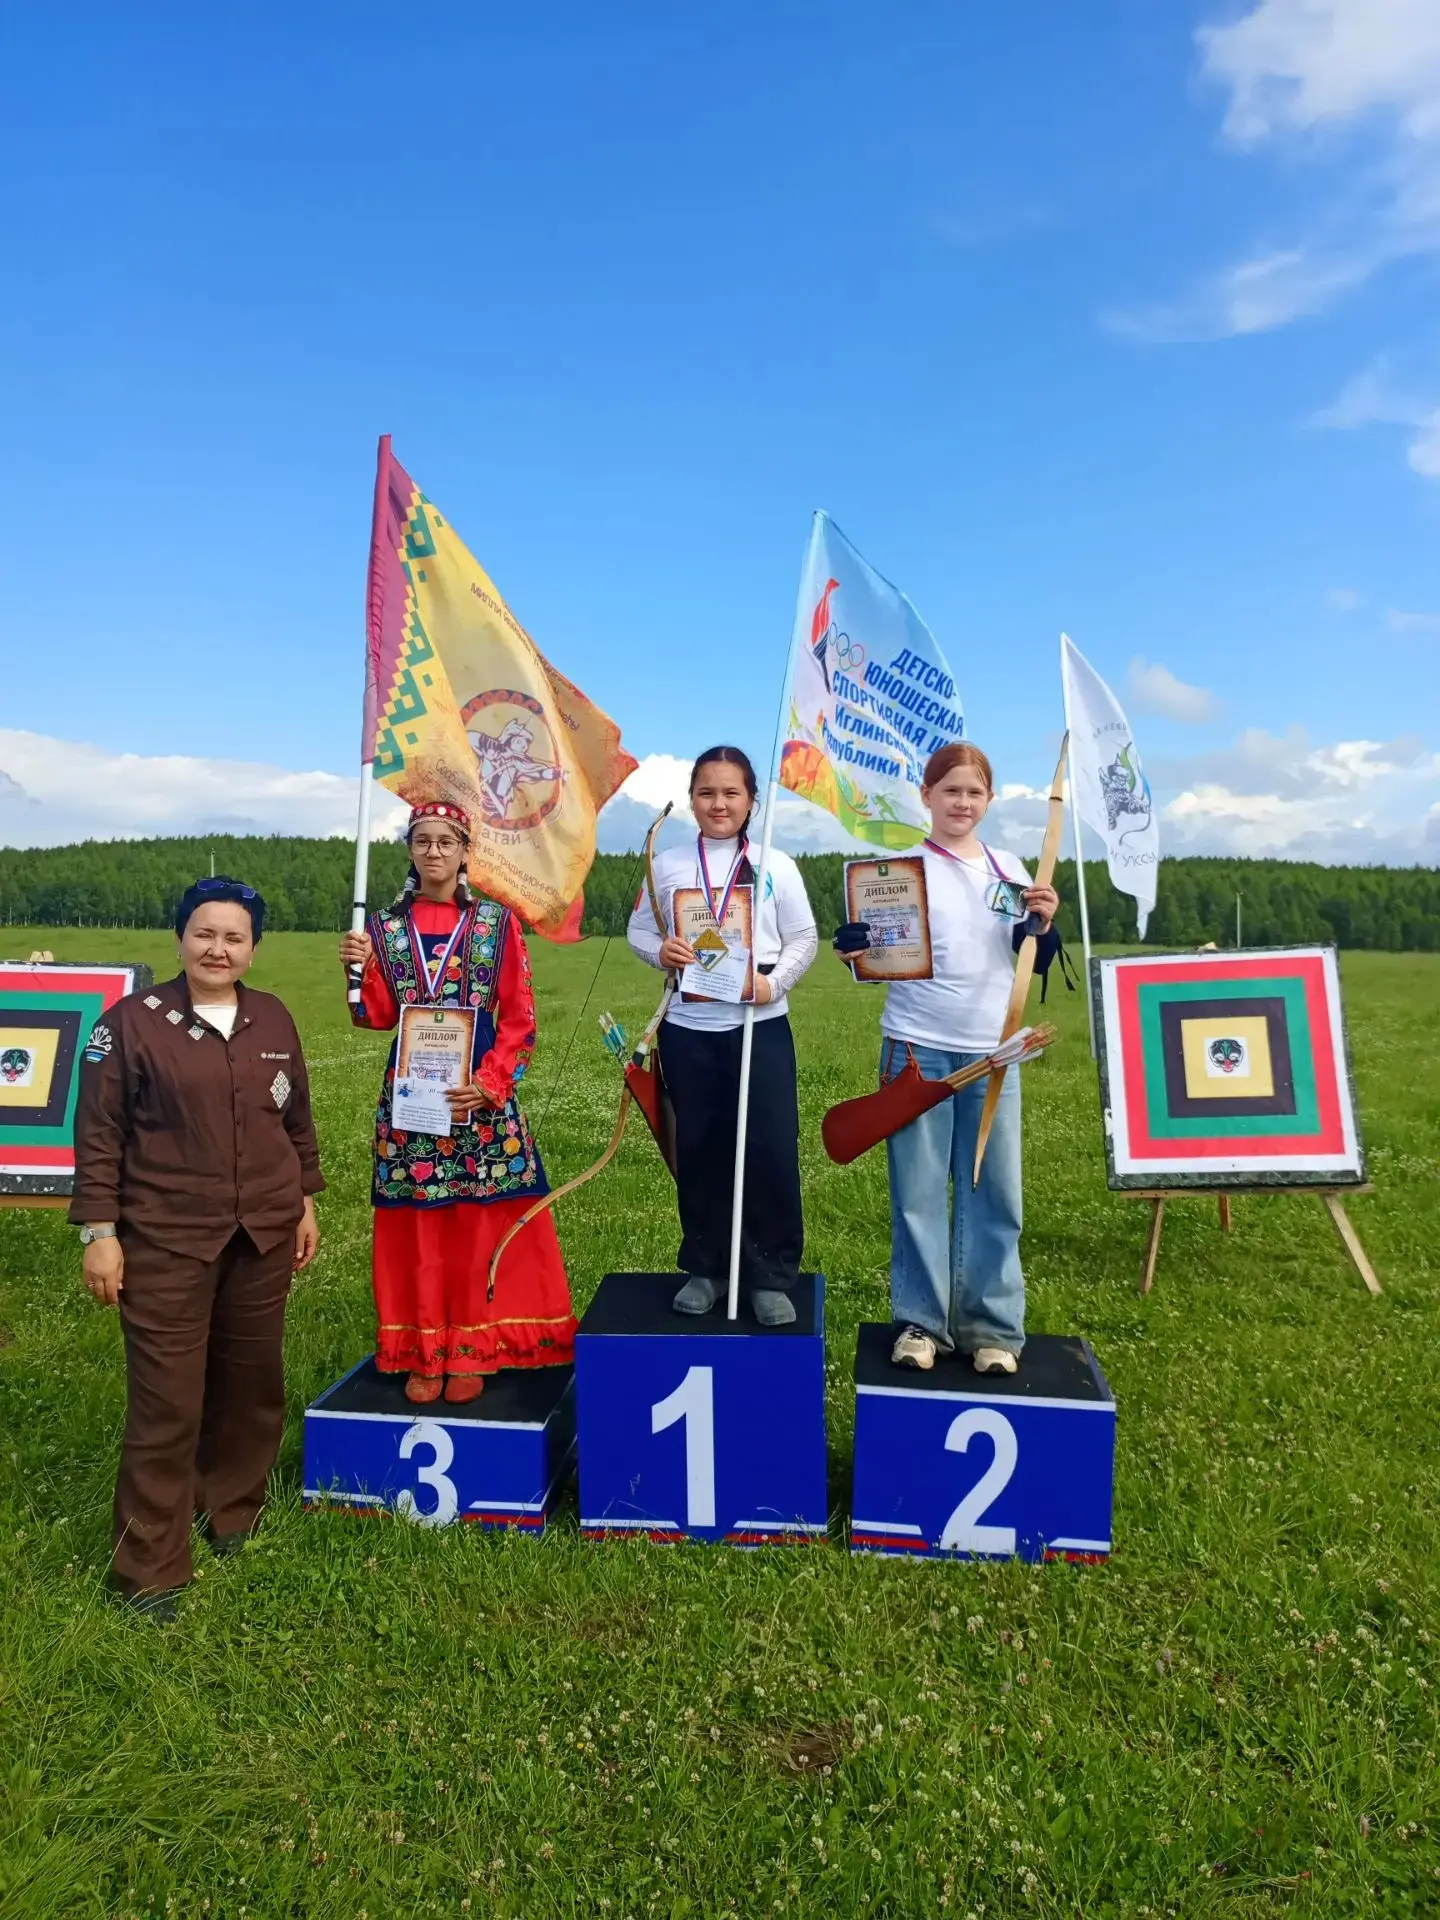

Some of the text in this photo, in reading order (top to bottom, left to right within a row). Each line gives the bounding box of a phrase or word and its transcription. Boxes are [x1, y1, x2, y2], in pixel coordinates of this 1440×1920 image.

[832, 670, 928, 748] СПОРТИВНАЯ
[863, 661, 964, 737] ЮНОШЕСКАЯ
[889, 648, 957, 699] ДЕТСКО-
[692, 911, 734, 922] ДИПМ
[864, 885, 908, 898] ДИПЛОМ
[418, 1032, 458, 1041] ДИПЛОМ
[397, 1421, 458, 1529] 3
[652, 1366, 715, 1527] 1
[940, 1407, 1018, 1555] 2
